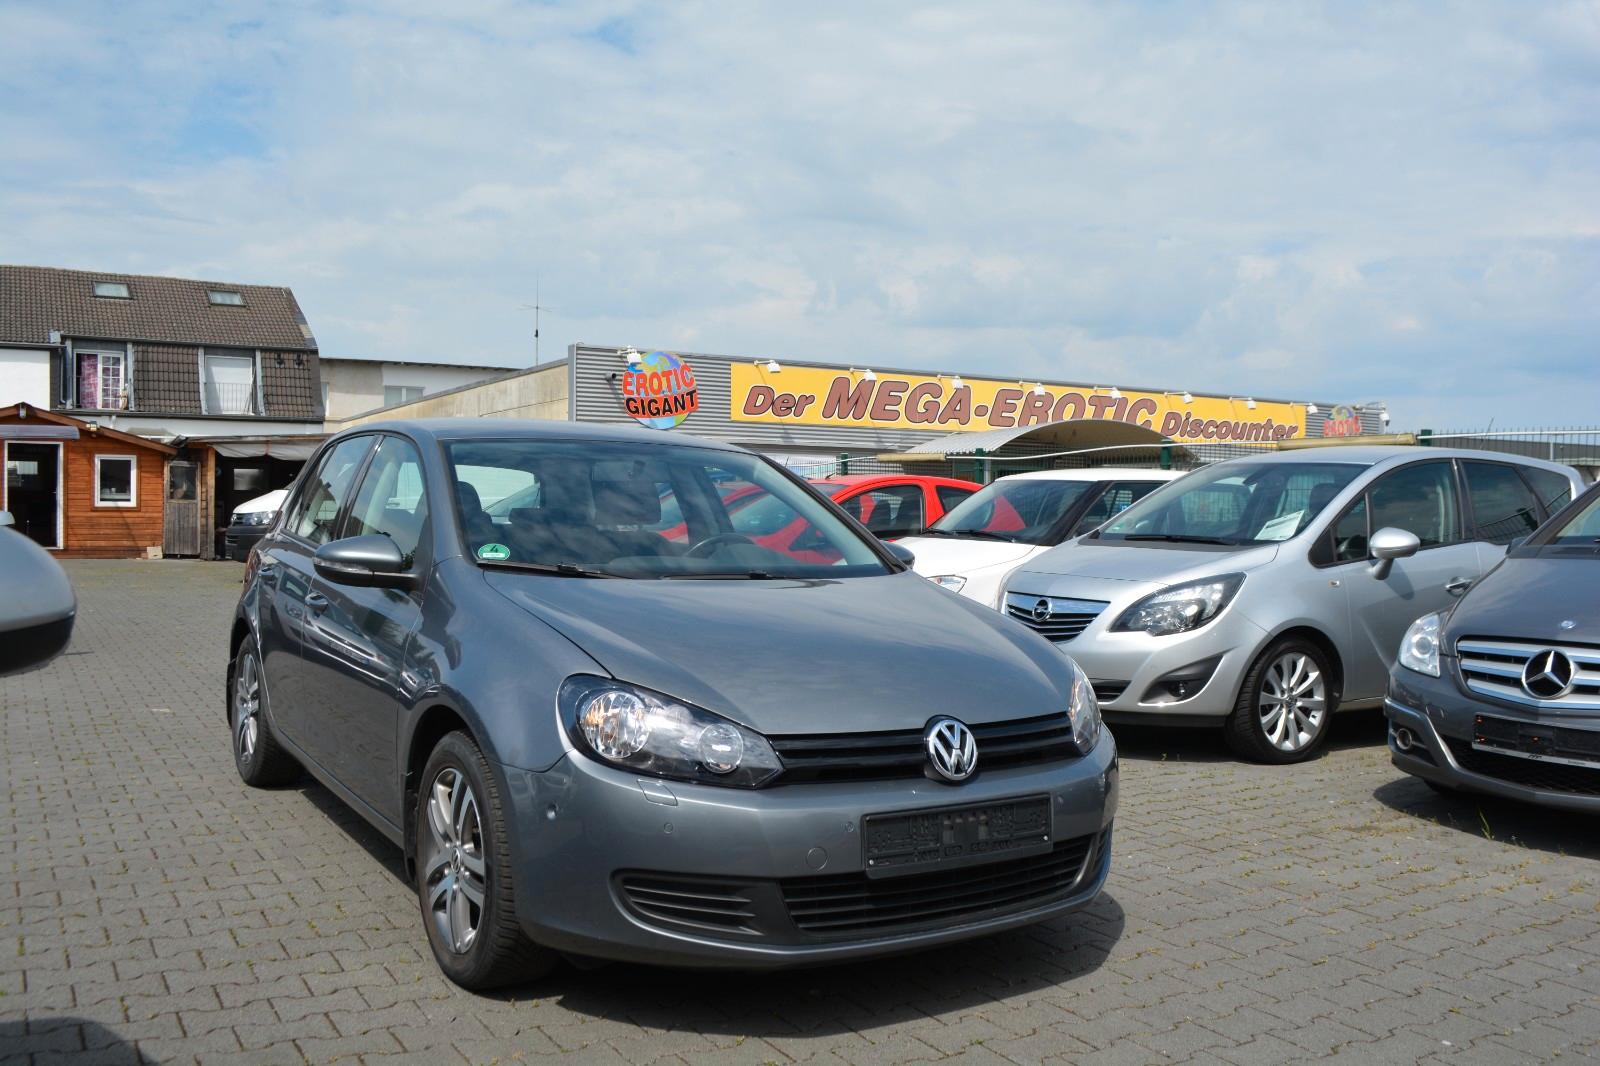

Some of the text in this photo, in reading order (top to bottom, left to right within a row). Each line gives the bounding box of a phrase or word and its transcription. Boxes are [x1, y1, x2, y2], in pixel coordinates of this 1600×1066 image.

[623, 364, 695, 396] EROTIC
[625, 390, 697, 416] GIGANT
[743, 377, 1299, 441] Der MEGA-EROTIC Discounter
